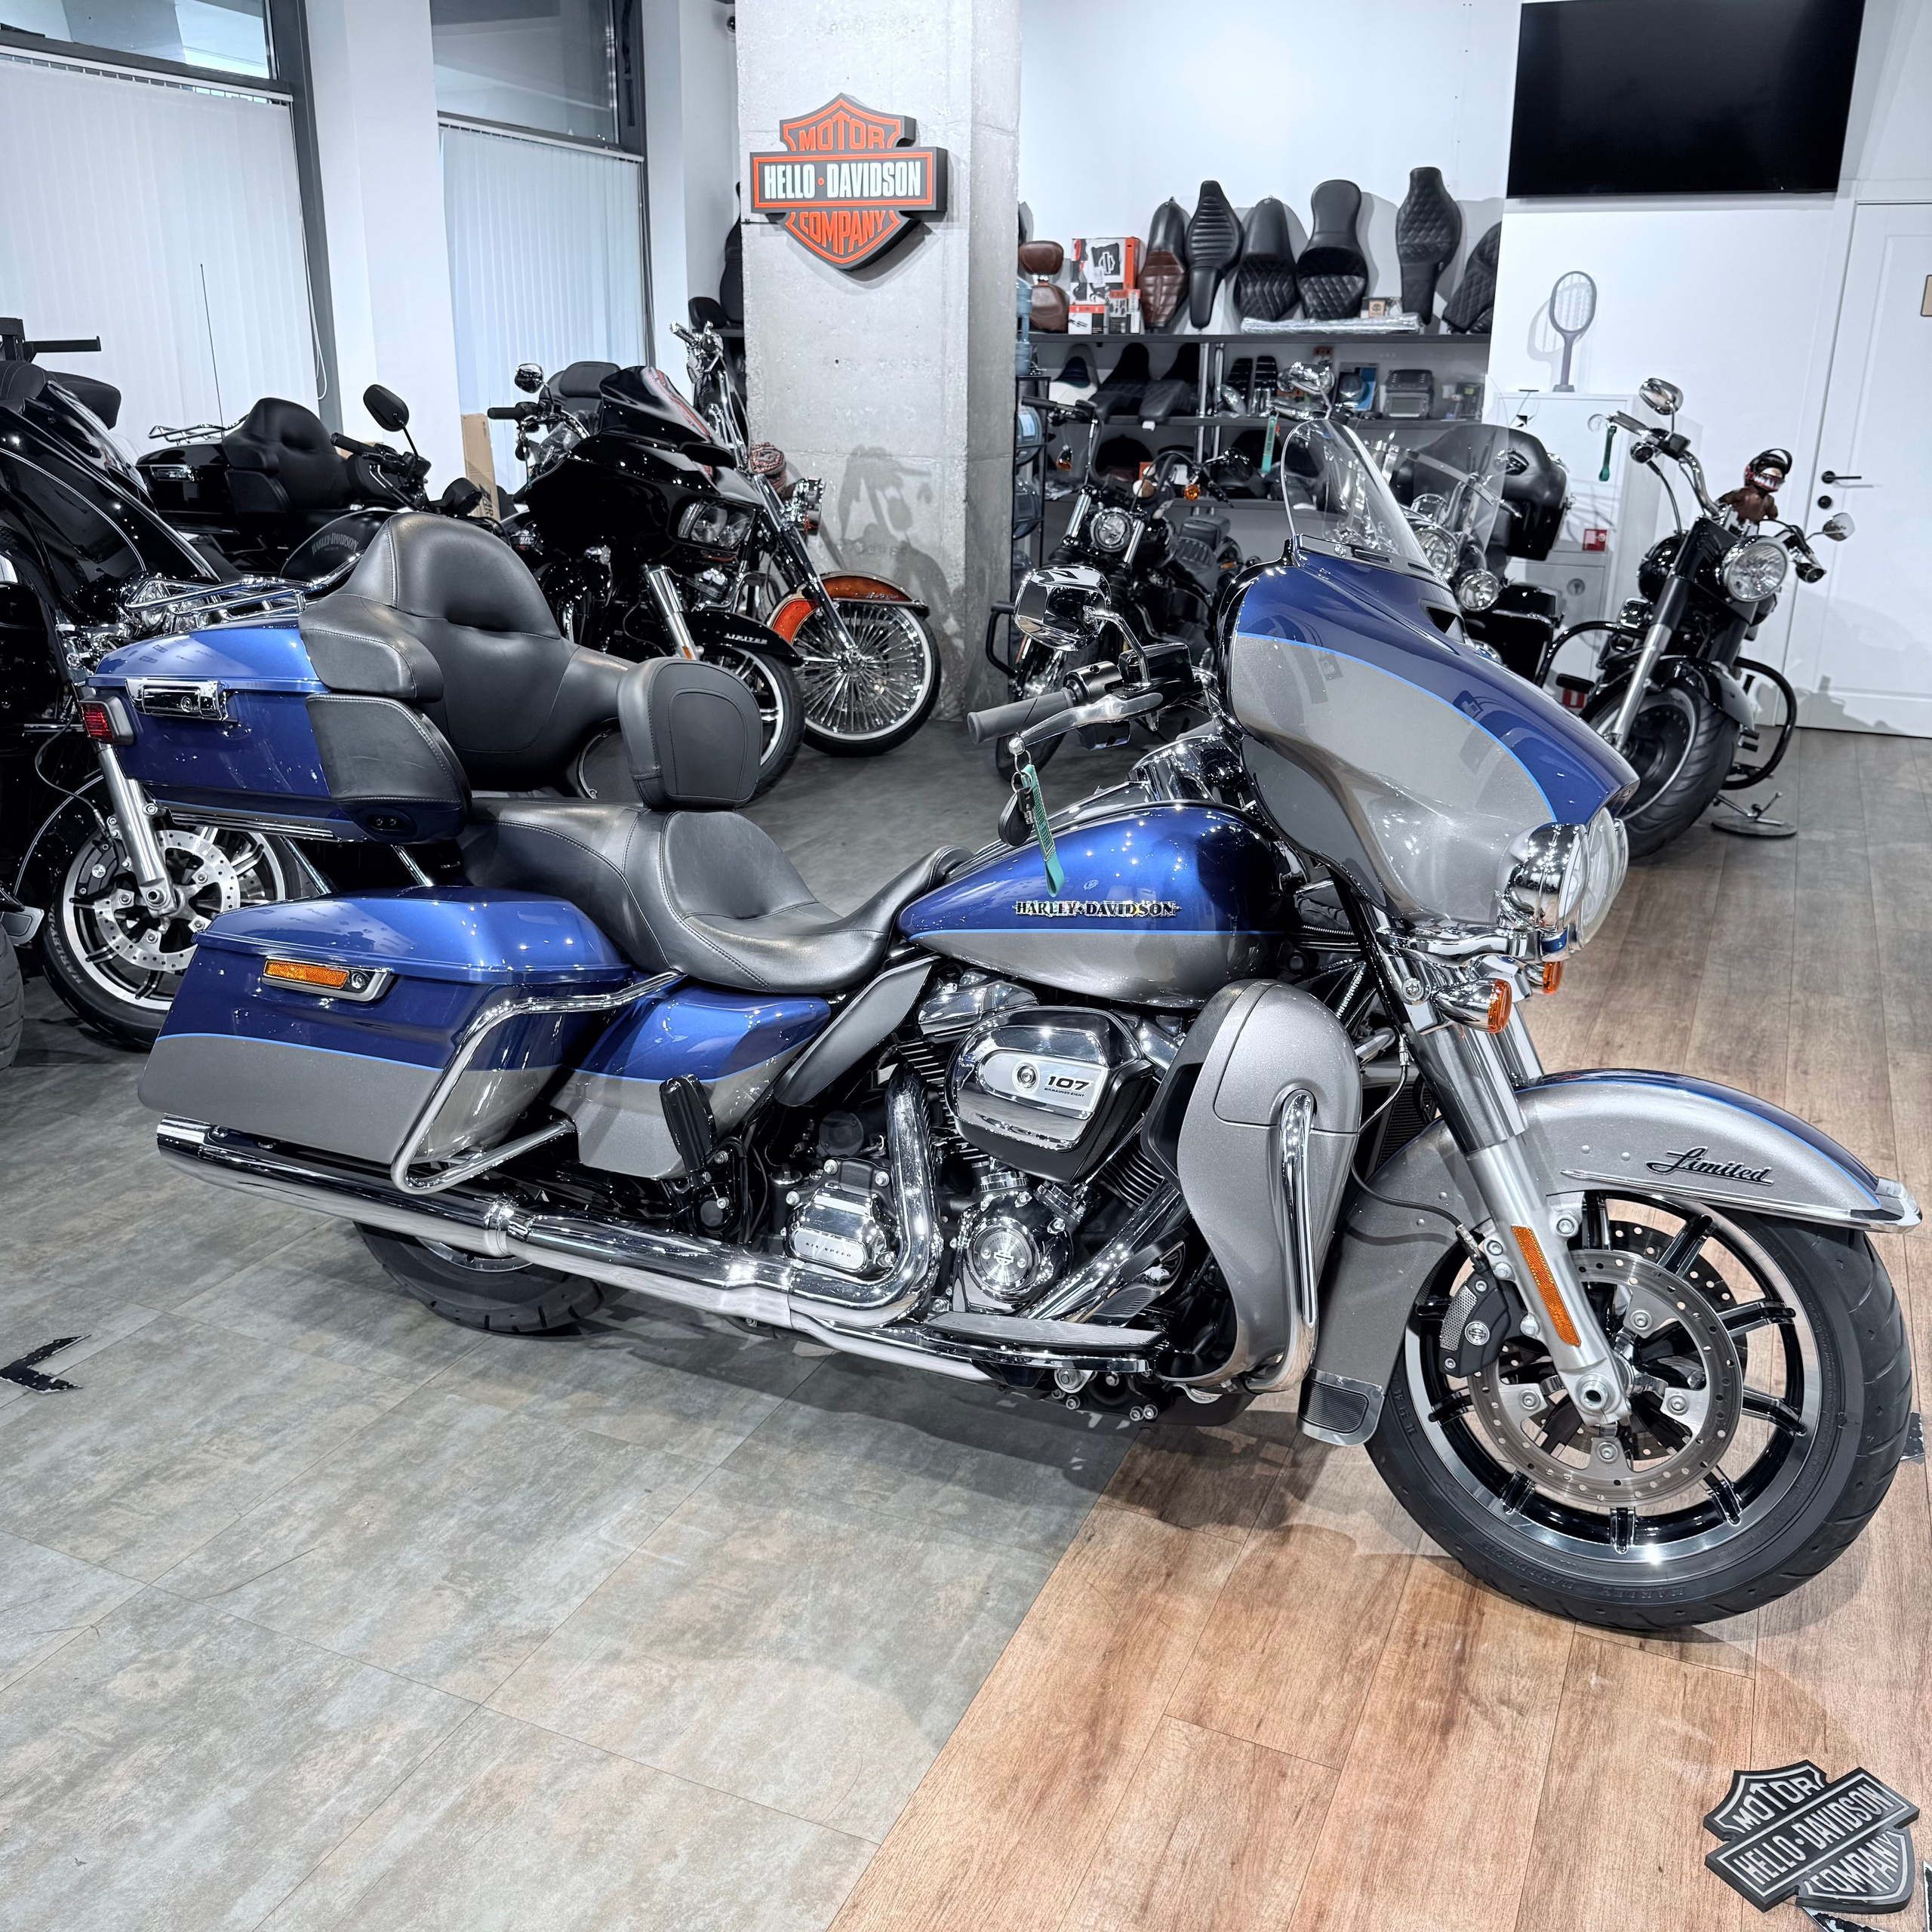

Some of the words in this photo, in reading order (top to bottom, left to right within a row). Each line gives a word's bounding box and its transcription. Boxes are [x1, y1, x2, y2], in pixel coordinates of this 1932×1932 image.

[798, 110, 885, 152] MOTOR
[764, 163, 816, 199] HELLO
[826, 161, 921, 198] DAVIDSON
[798, 210, 886, 256] COMPANY
[1047, 1075, 1091, 1091] 107
[1645, 1146, 1774, 1186] Limited
[1731, 1777, 1822, 1831] MOTOR
[1733, 1835, 1807, 1885] HELLO
[1791, 1783, 1897, 1850] DAVIDSON
[1810, 1830, 1900, 1894] COMPANY
